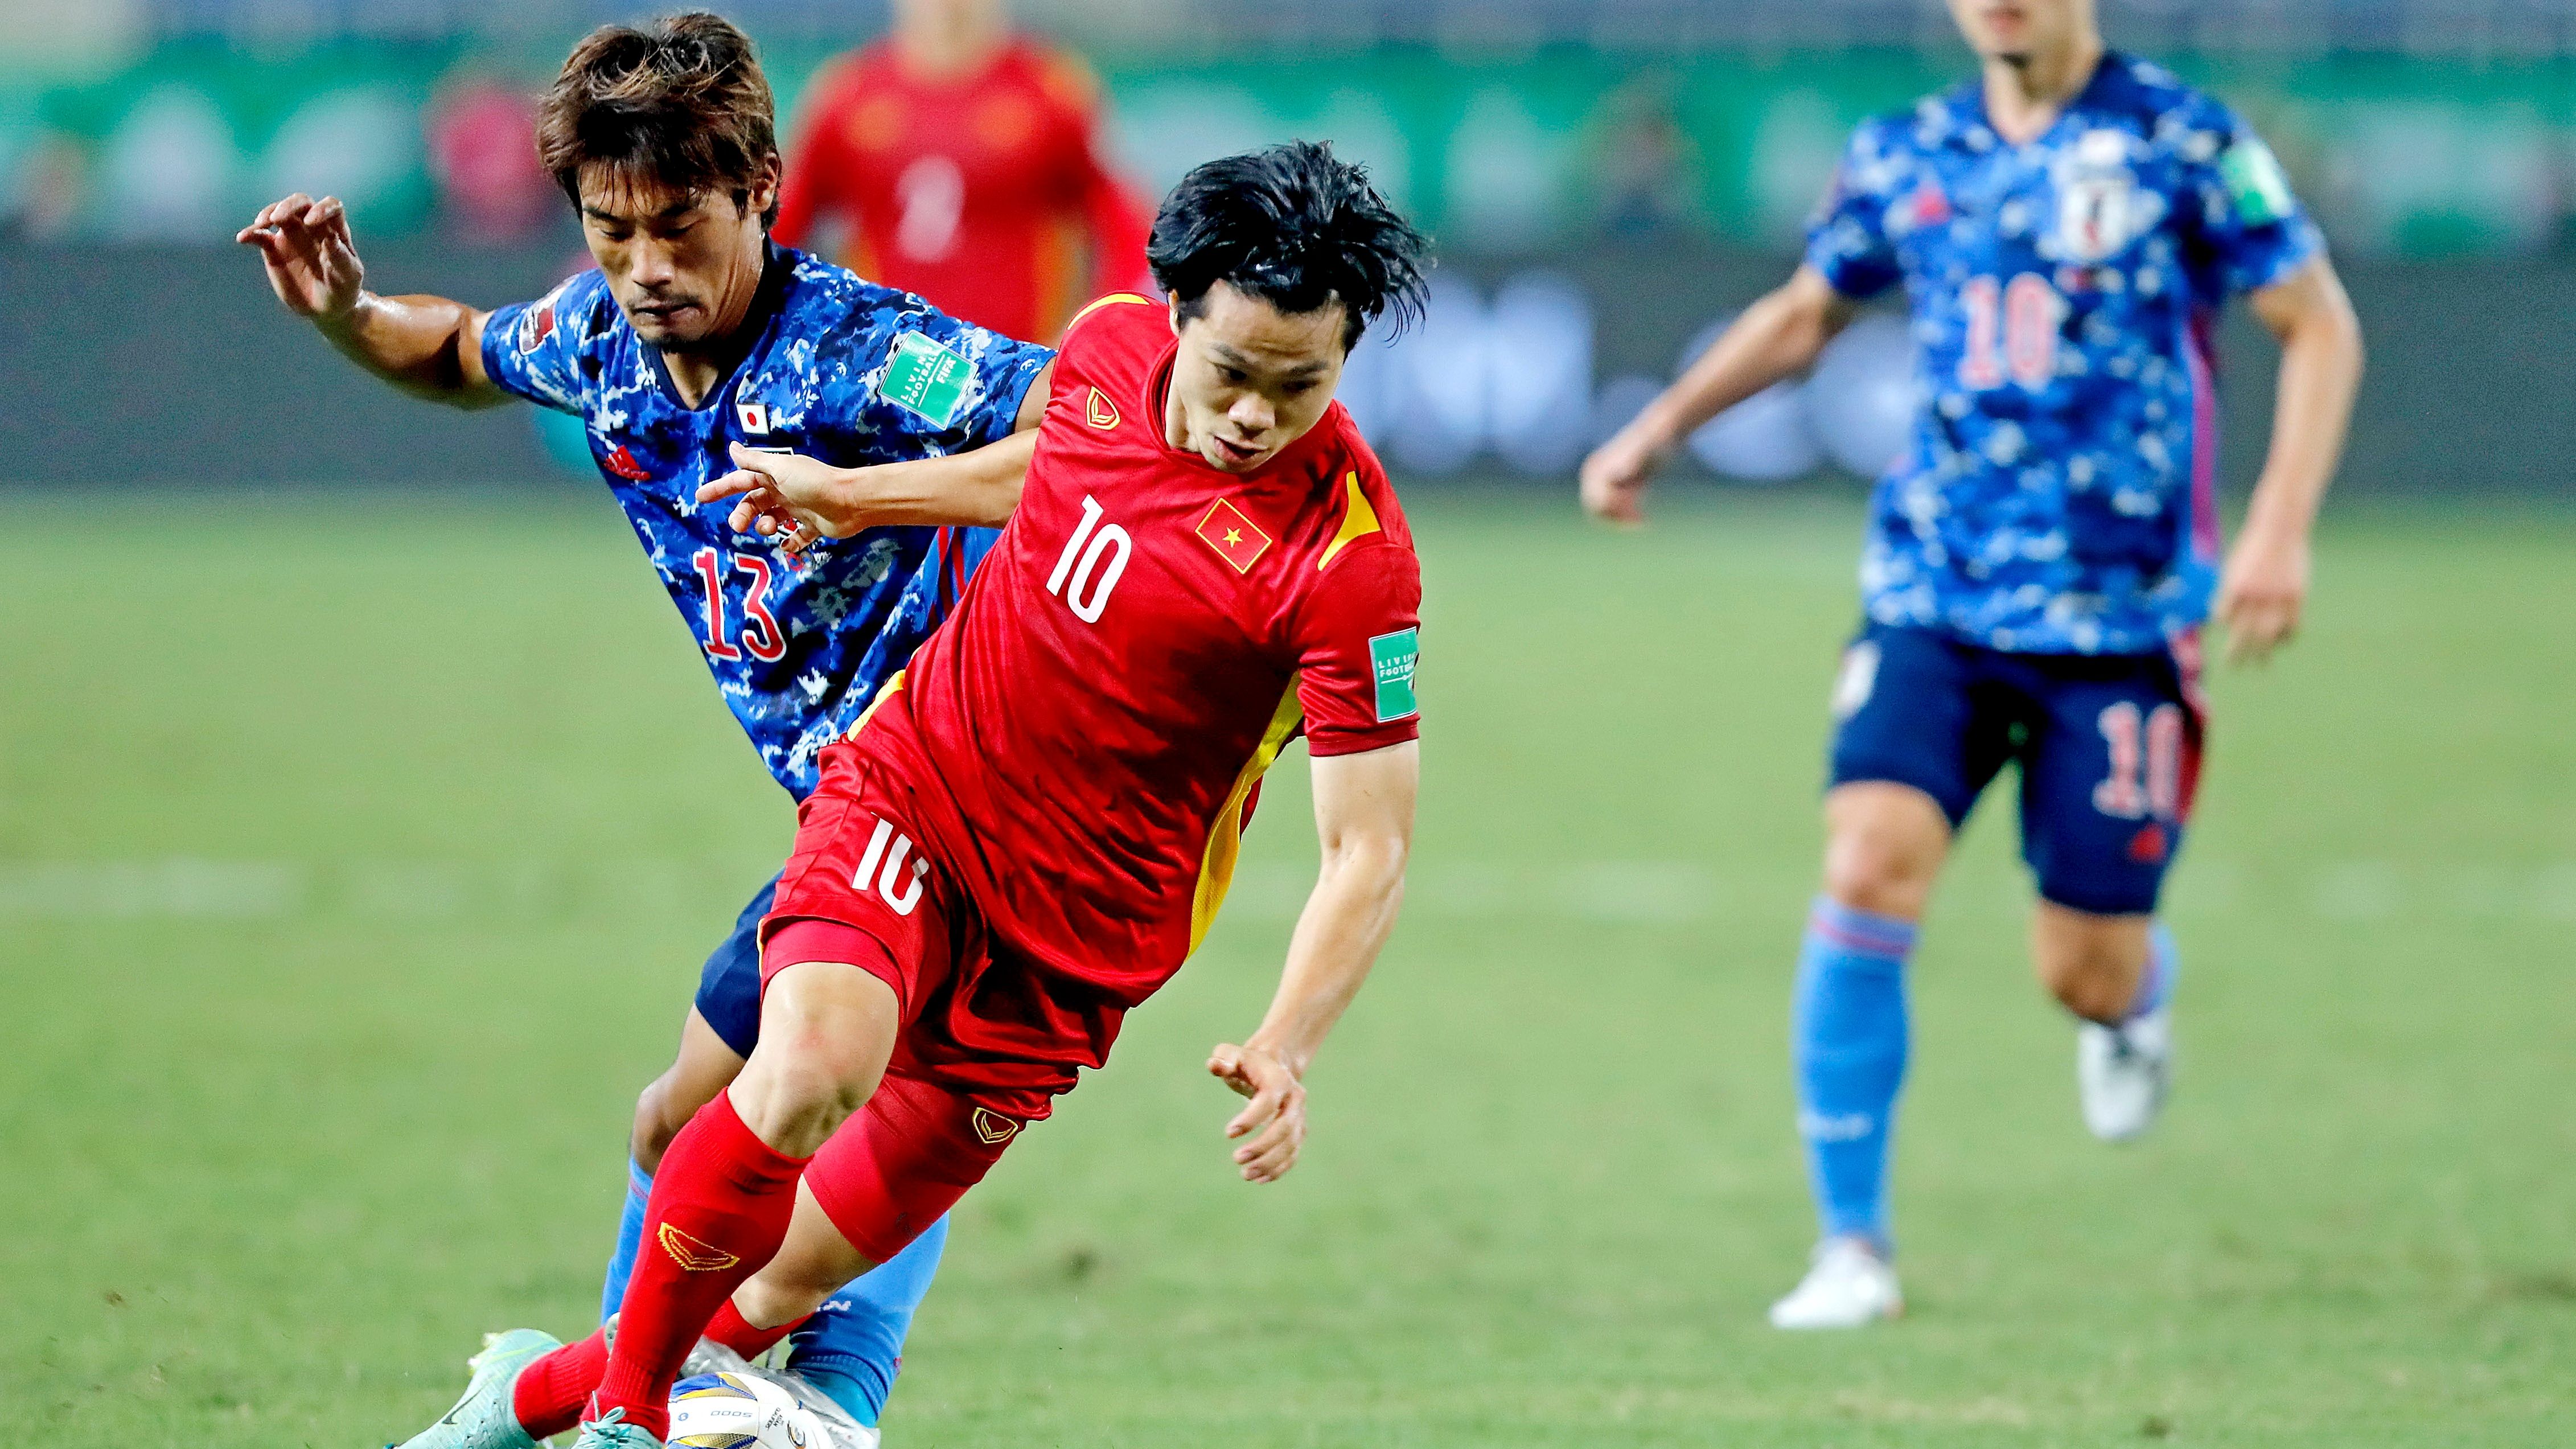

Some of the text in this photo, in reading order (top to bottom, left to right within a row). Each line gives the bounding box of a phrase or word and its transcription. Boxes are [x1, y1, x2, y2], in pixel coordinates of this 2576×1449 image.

[907, 348, 939, 405] FOOTBALL
[936, 356, 957, 384] FIFA
[1958, 274, 2056, 392] 10
[693, 546, 787, 662] 13
[1046, 494, 1132, 623] 10
